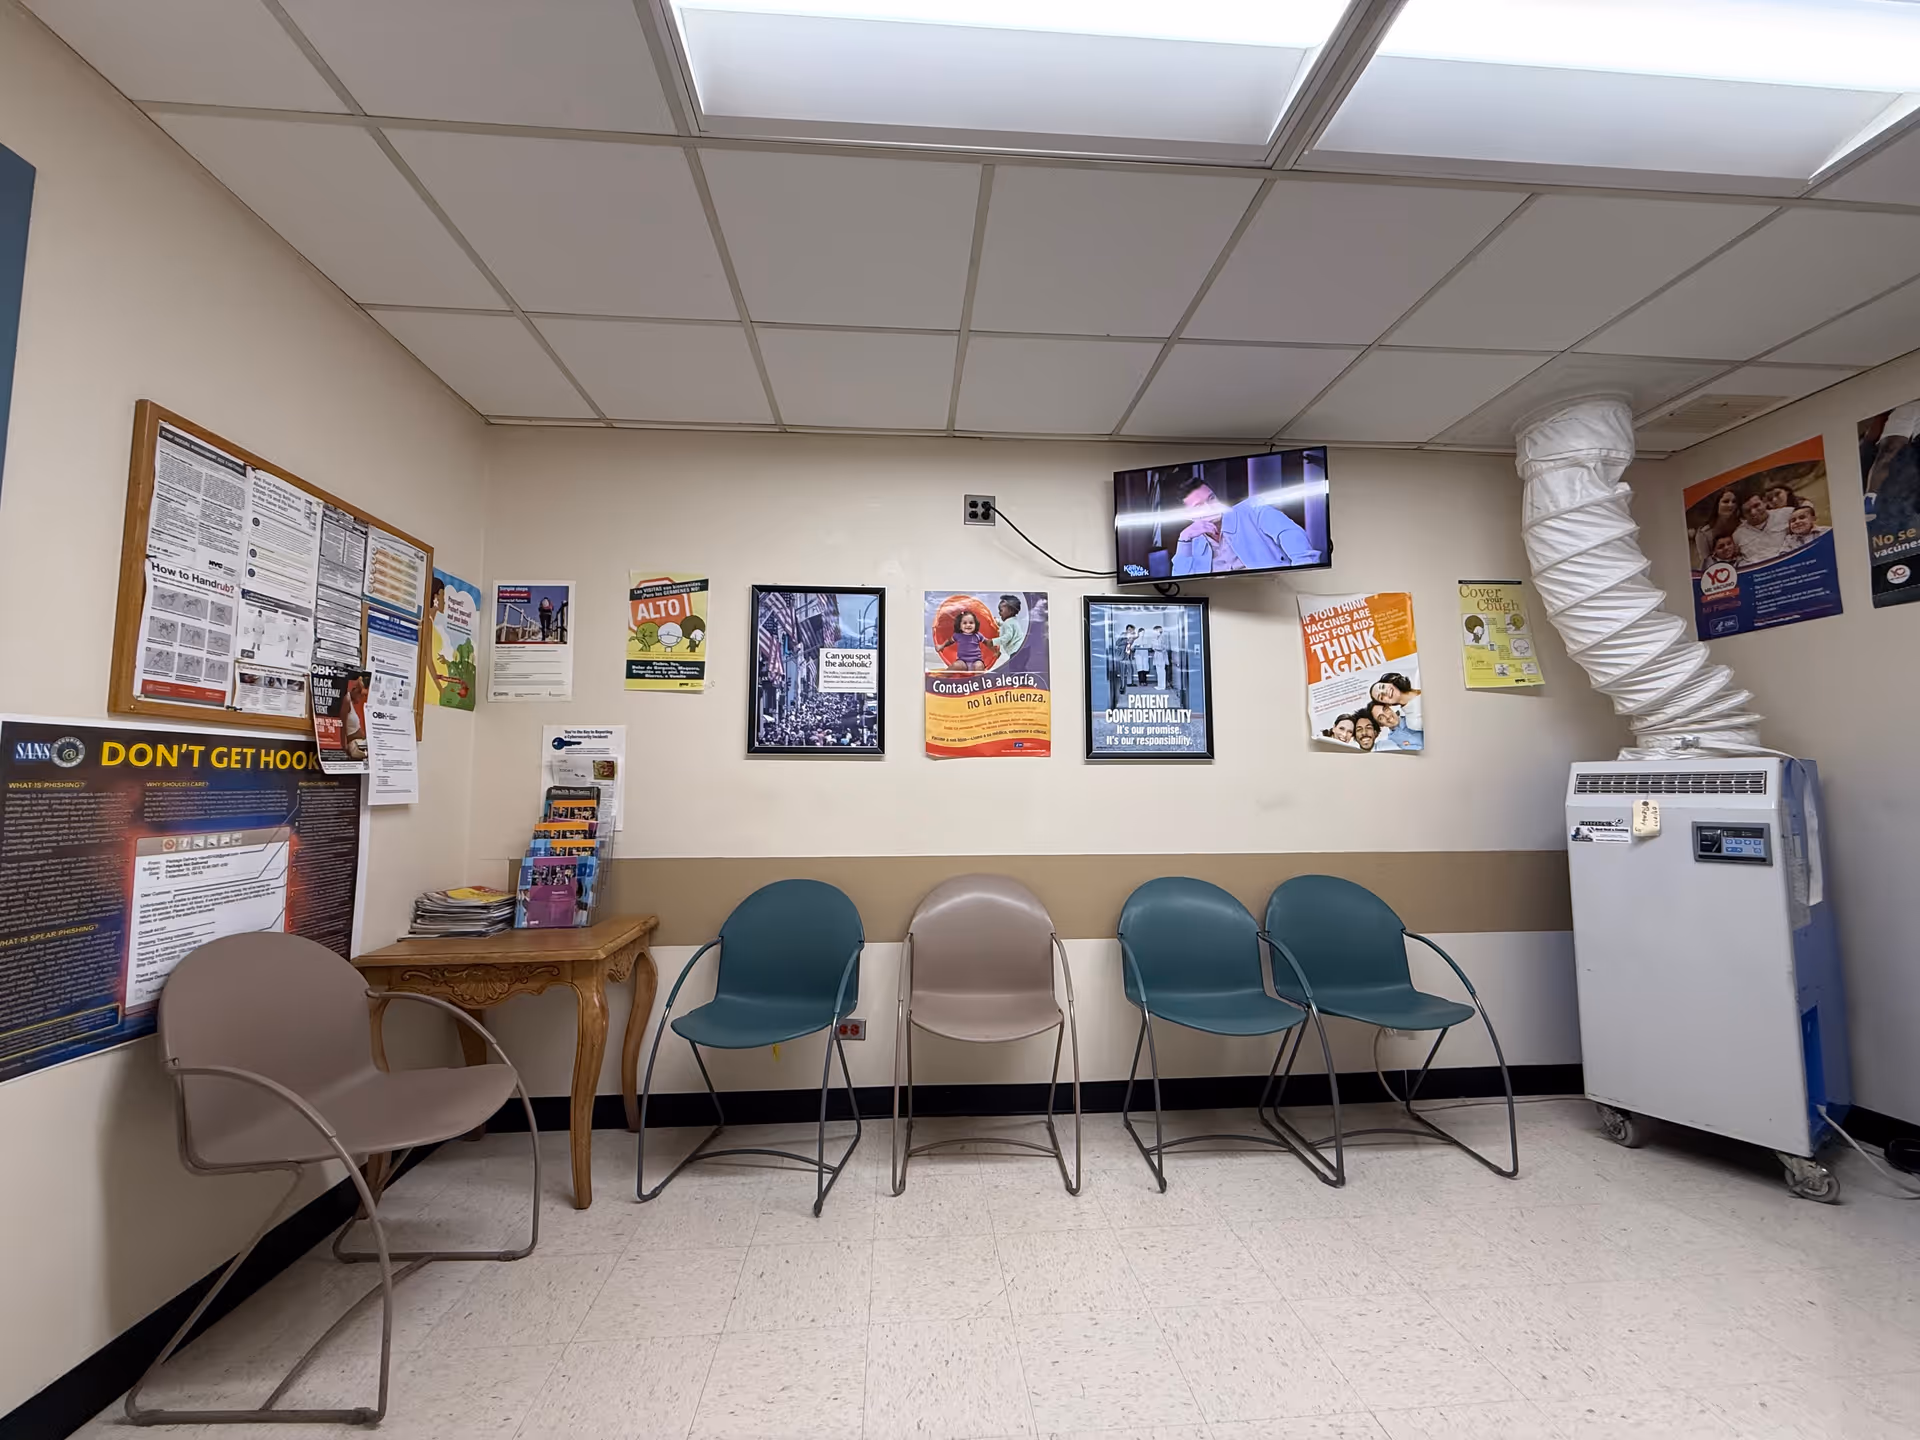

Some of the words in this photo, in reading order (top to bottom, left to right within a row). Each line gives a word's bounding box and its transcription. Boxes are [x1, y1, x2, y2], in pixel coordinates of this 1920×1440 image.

[1872, 534, 1895, 548] No
[1898, 528, 1917, 541] se
[151, 561, 177, 577] How
[179, 569, 190, 581] to
[192, 573, 235, 594] Handrub?
[643, 585, 662, 593] VISITAS
[1459, 584, 1502, 599] Cover
[637, 598, 680, 620] ALTO
[1476, 598, 1520, 615] Cough
[1483, 597, 1503, 605] your
[1302, 614, 1312, 625] IF
[1312, 607, 1334, 621] YOU
[1336, 598, 1367, 615] THINK
[1304, 613, 1352, 634] VACCINES
[1352, 608, 1371, 621] ARE
[1308, 630, 1331, 645] JUST
[1331, 624, 1352, 637] FOR
[1352, 617, 1375, 631] KIDS
[1310, 627, 1380, 663] THINK
[825, 651, 840, 660] Can
[840, 653, 855, 661] you
[855, 652, 871, 661] spot
[825, 660, 838, 668] the
[837, 660, 873, 668] alcoholic?
[1320, 645, 1387, 683] AGAIN
[313, 677, 333, 688] BLACK
[932, 679, 980, 696] Contagie
[981, 677, 993, 689] la
[995, 673, 1038, 688] alegría,
[313, 686, 341, 698] MATERNAL
[314, 695, 333, 706] HEALTH
[967, 699, 980, 710] no
[982, 695, 993, 706] la
[995, 690, 1047, 704] influenza.
[1128, 694, 1169, 708] PATIENT
[1105, 709, 1192, 723] CONFIDENTIALITY
[1117, 724, 1130, 734] It's
[1131, 726, 1144, 734] our
[1146, 724, 1182, 735] promise.
[1106, 736, 1119, 745] It's
[1121, 736, 1135, 745] our
[1136, 735, 1193, 746] responsibility.
[15, 742, 51, 759] SANS
[101, 742, 205, 767] DON'T
[210, 747, 255, 768] GET
[19, 936, 28, 944] IS
[30, 931, 57, 942] SPEAR
[58, 924, 99, 937] PHISHING?
